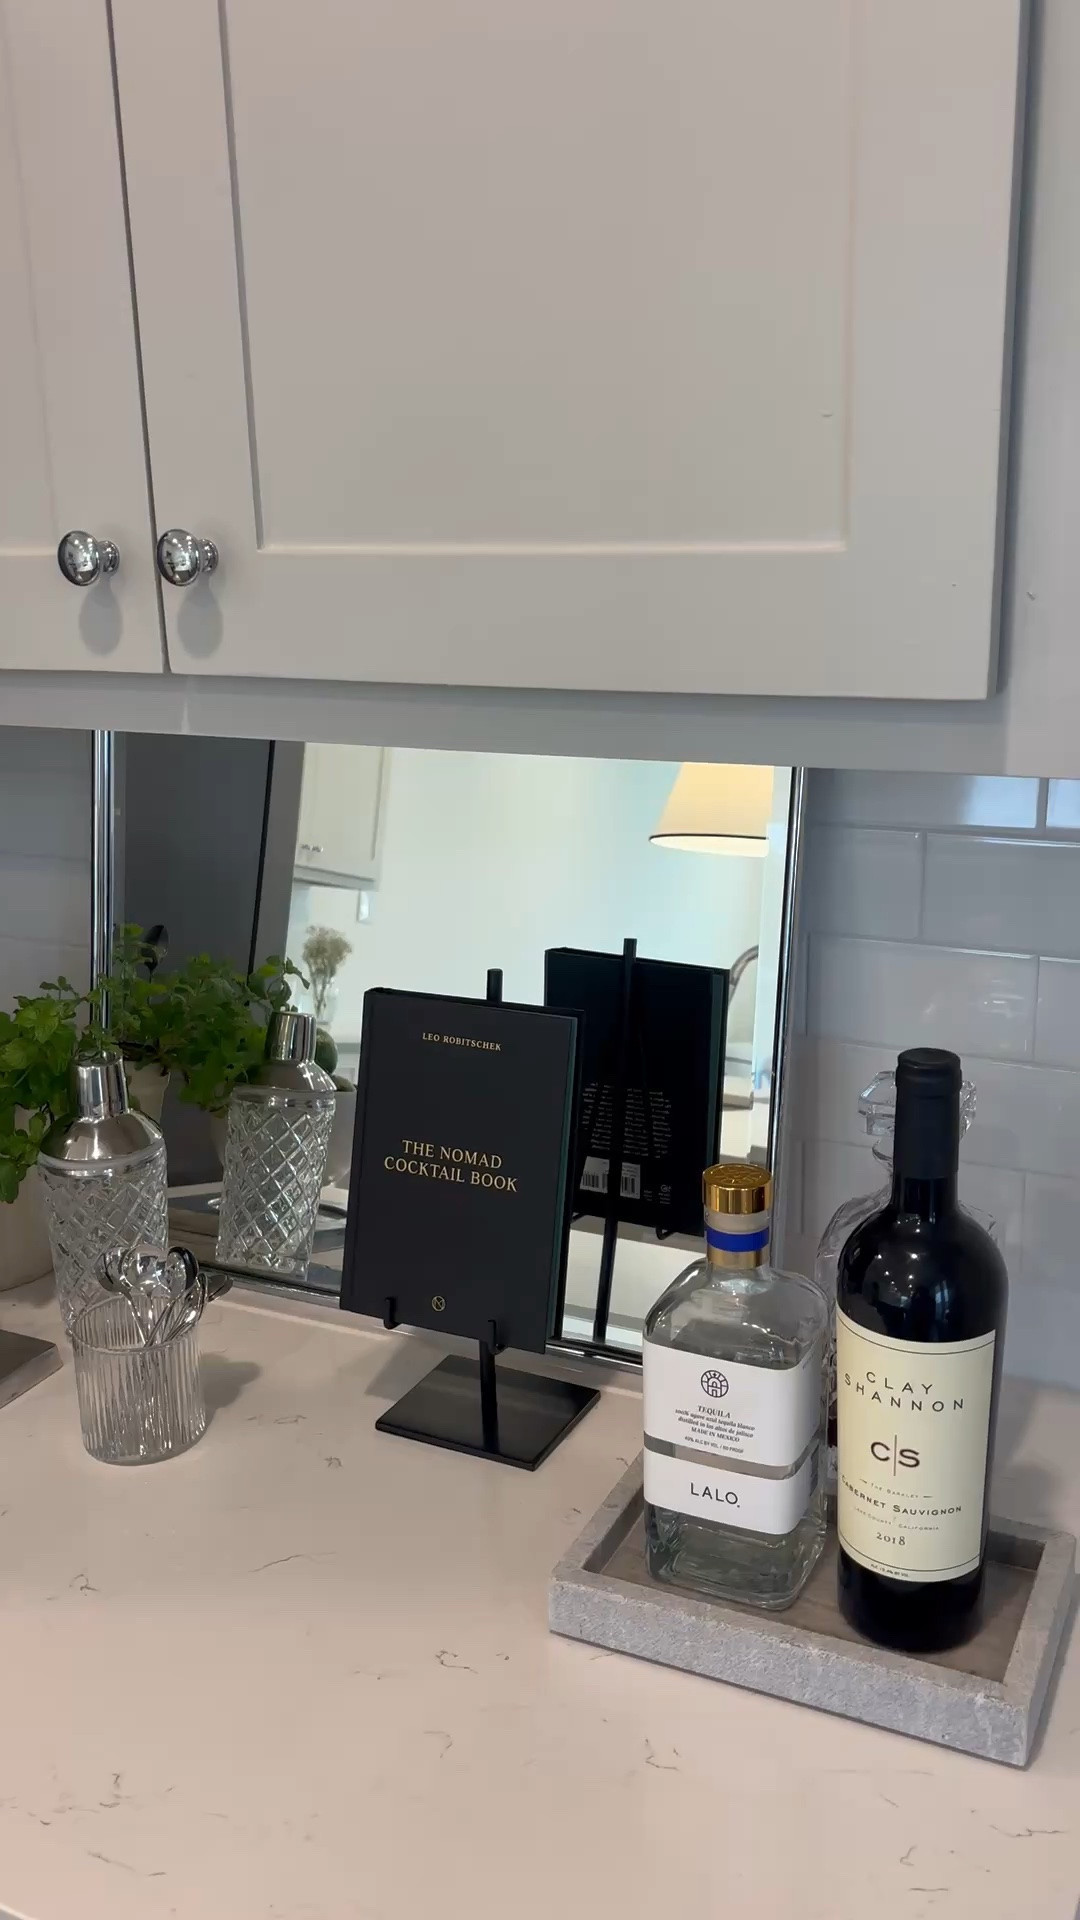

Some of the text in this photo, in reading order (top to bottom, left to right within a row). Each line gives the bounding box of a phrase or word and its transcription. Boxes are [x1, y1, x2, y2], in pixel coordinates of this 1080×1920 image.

[422, 1032, 502, 1051] LEO ROBITSCHEK
[402, 1139, 502, 1169] THE NOMAD
[384, 1156, 518, 1192] COCKTAIL BOOK
[844, 1373, 965, 1412] SHANNON
[866, 1371, 933, 1395] CLAY
[698, 1405, 731, 1419] TEQUILA
[691, 1426, 709, 1436] MADE
[717, 1432, 740, 1443] MEXICO
[690, 1482, 741, 1508] LALO.
[876, 1532, 906, 1546] 2018
